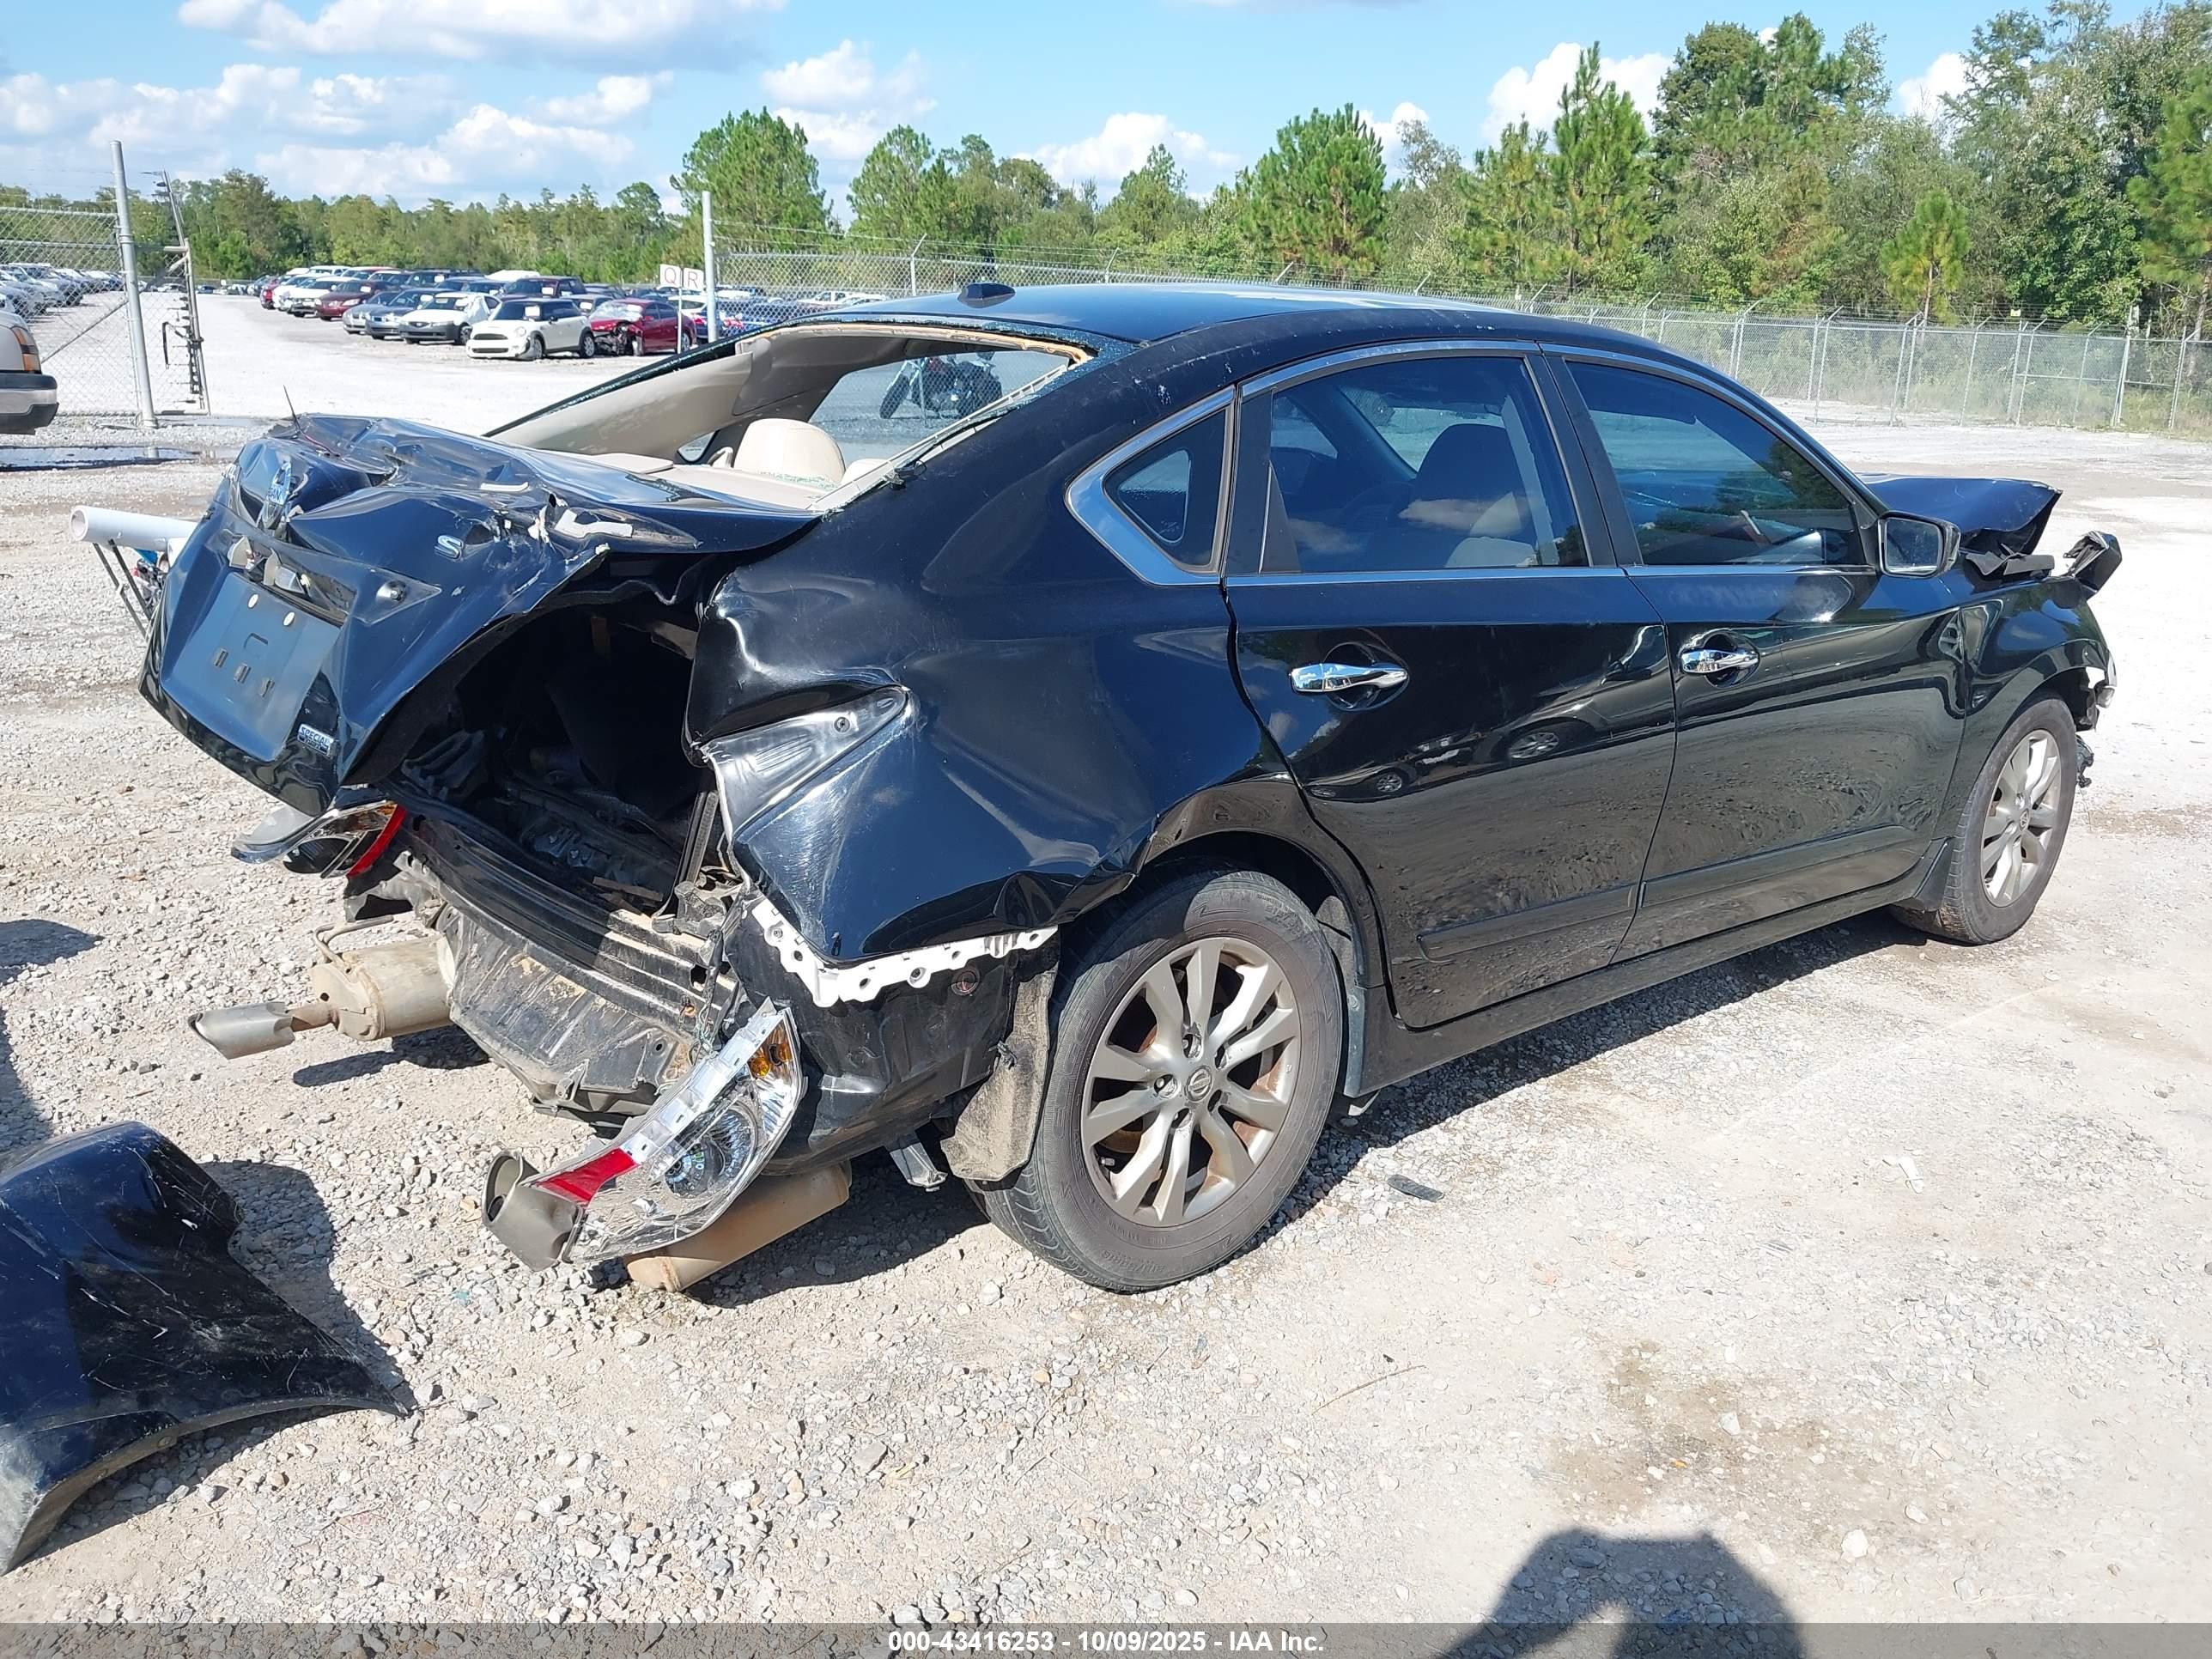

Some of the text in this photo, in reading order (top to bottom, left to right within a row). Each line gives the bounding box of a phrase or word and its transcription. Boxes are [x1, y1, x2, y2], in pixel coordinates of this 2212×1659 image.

[664, 267, 678, 285] Q
[687, 270, 699, 289] R
[434, 534, 464, 560] S
[300, 726, 330, 750] SPECIAL
